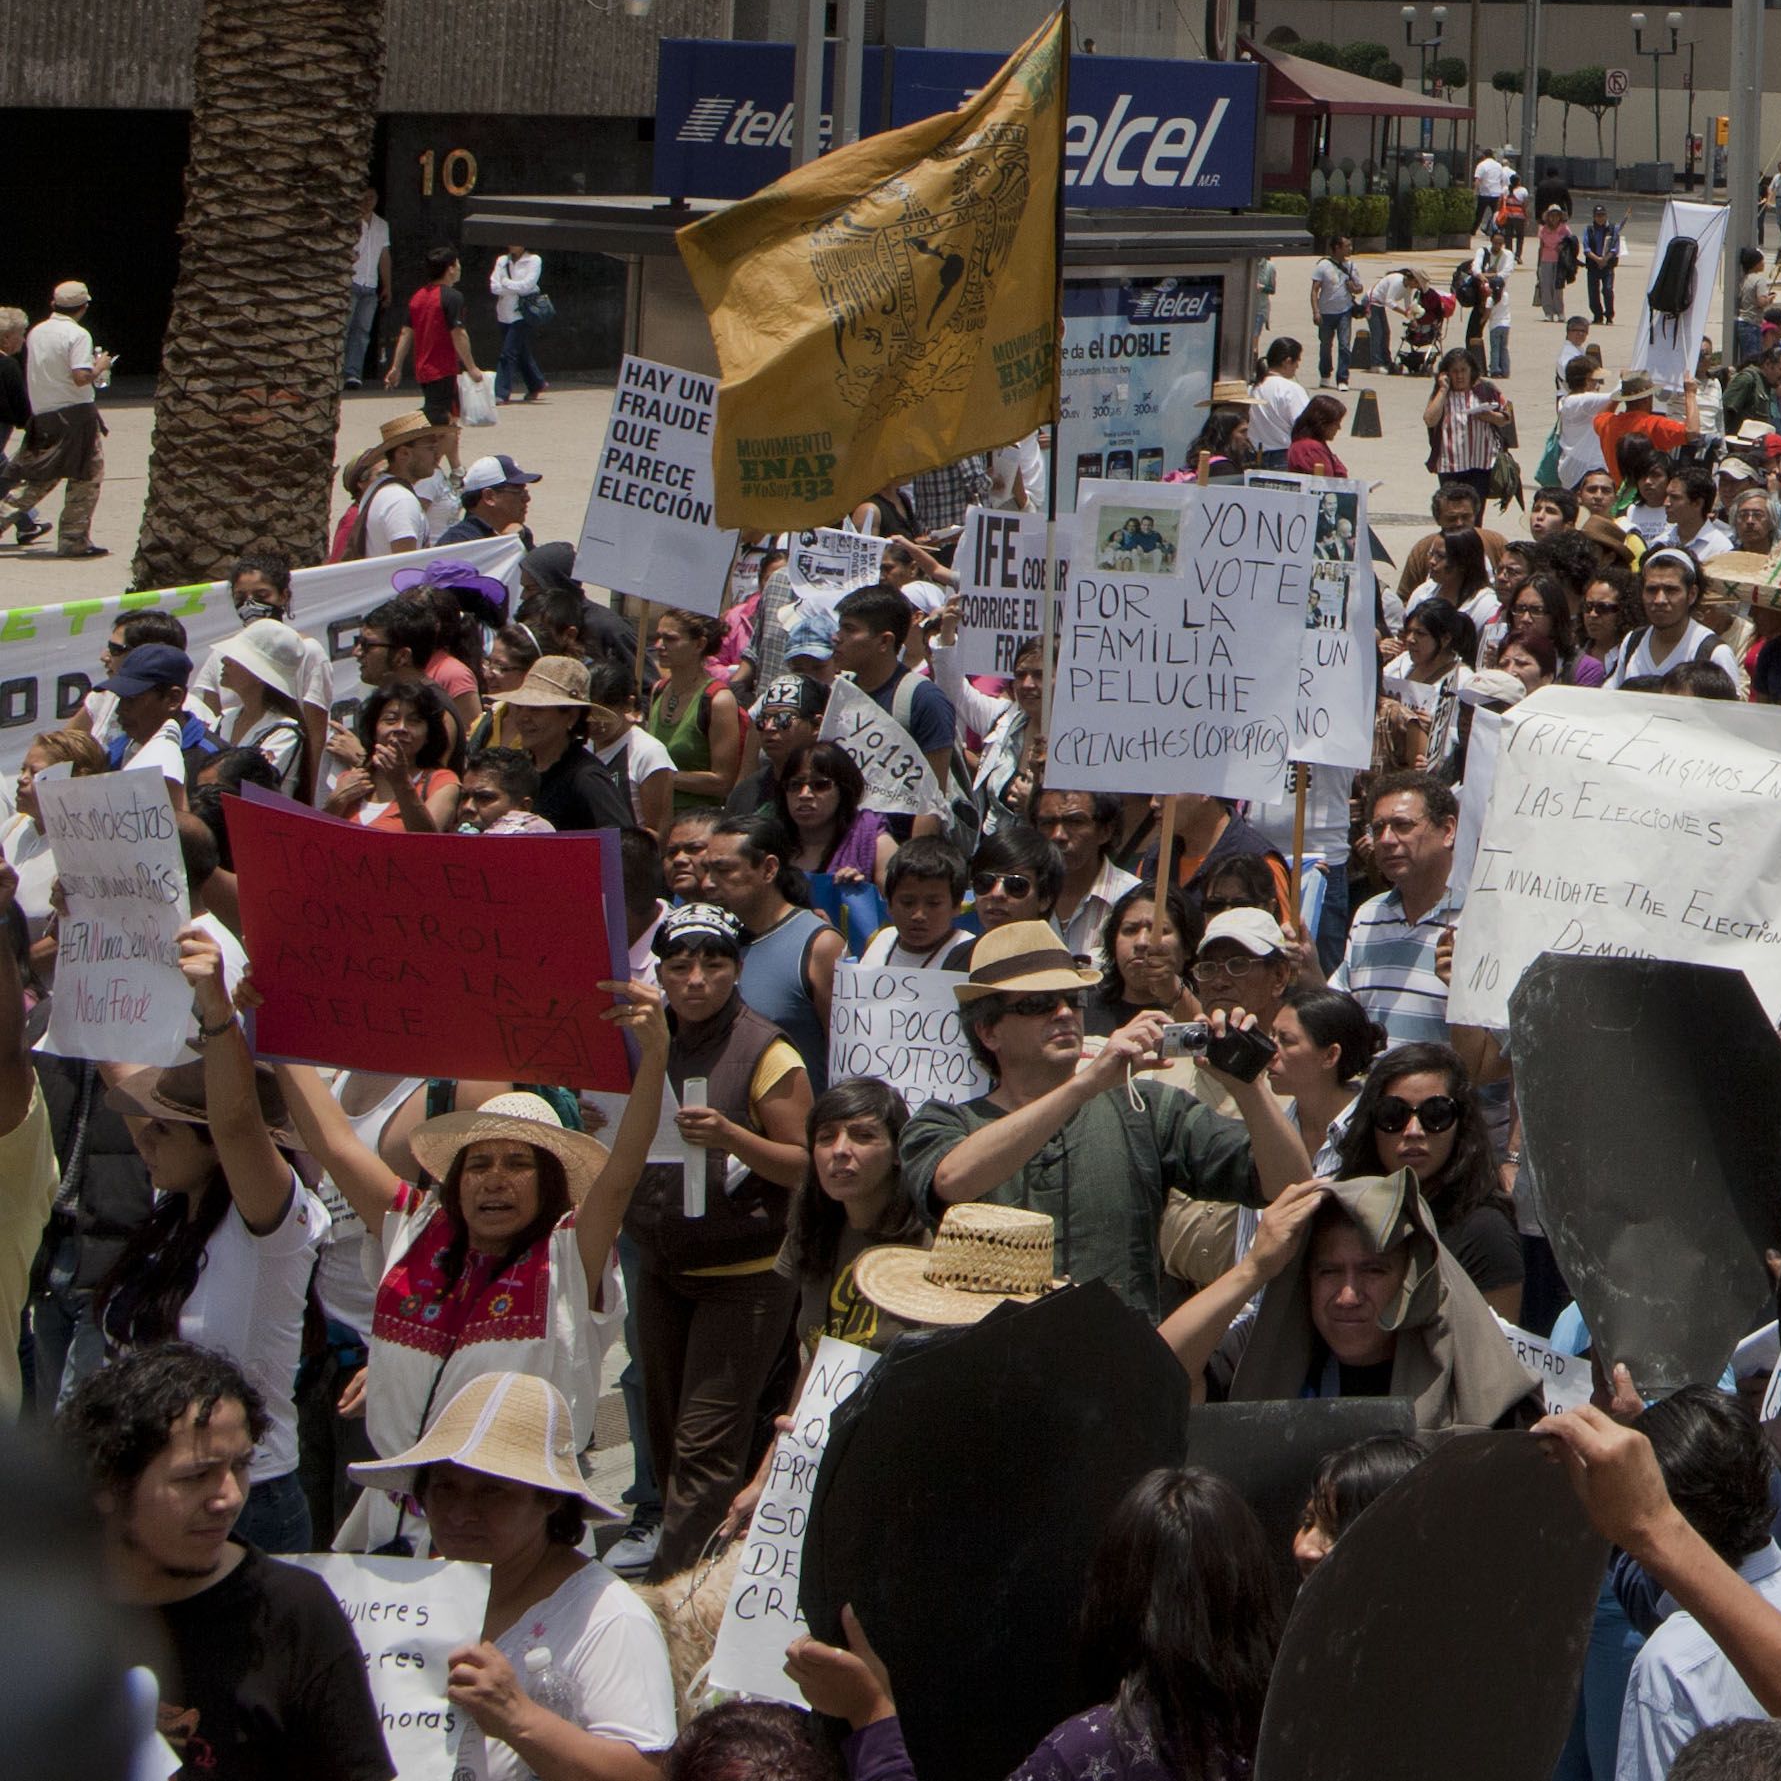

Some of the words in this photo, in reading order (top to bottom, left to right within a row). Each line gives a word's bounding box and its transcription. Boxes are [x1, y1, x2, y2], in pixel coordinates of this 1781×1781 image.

[420, 149, 478, 196] 10
[1153, 291, 1210, 318] telcel
[1089, 333, 1104, 359] el
[1109, 331, 1171, 358] DOBLE
[624, 362, 674, 394] HAY
[679, 376, 714, 406] UN
[618, 391, 712, 435] FRAUDE
[612, 420, 661, 452] QUE
[736, 431, 833, 459] MOVIMIENTO
[604, 448, 696, 491] PARECE
[738, 454, 838, 482] ENAP
[597, 476, 713, 526] ELECCIÓN
[1201, 502, 1246, 548] YO
[1257, 510, 1307, 553] NO
[974, 514, 1021, 588] IFE
[1194, 557, 1303, 606] VOTE
[961, 594, 1020, 630] CORRIGE
[1023, 599, 1039, 631] EL
[1077, 580, 1151, 620] POR
[1182, 598, 1236, 632] LA
[1316, 639, 1349, 667] UN
[1070, 668, 1256, 713] PELUCHE
[1507, 709, 1594, 761] TRIFE
[877, 742, 924, 792] 132
[1514, 781, 1563, 820] LAS
[265, 829, 426, 894] TOMA
[440, 862, 518, 906] EL
[275, 940, 432, 988] APAGA
[460, 965, 524, 1001] LA
[833, 970, 920, 1003] LLOS
[1468, 952, 1500, 992] NO
[300, 992, 446, 1038] TELE
[833, 1042, 980, 1087] NOSOTROS
[380, 1702, 455, 1733] horas
